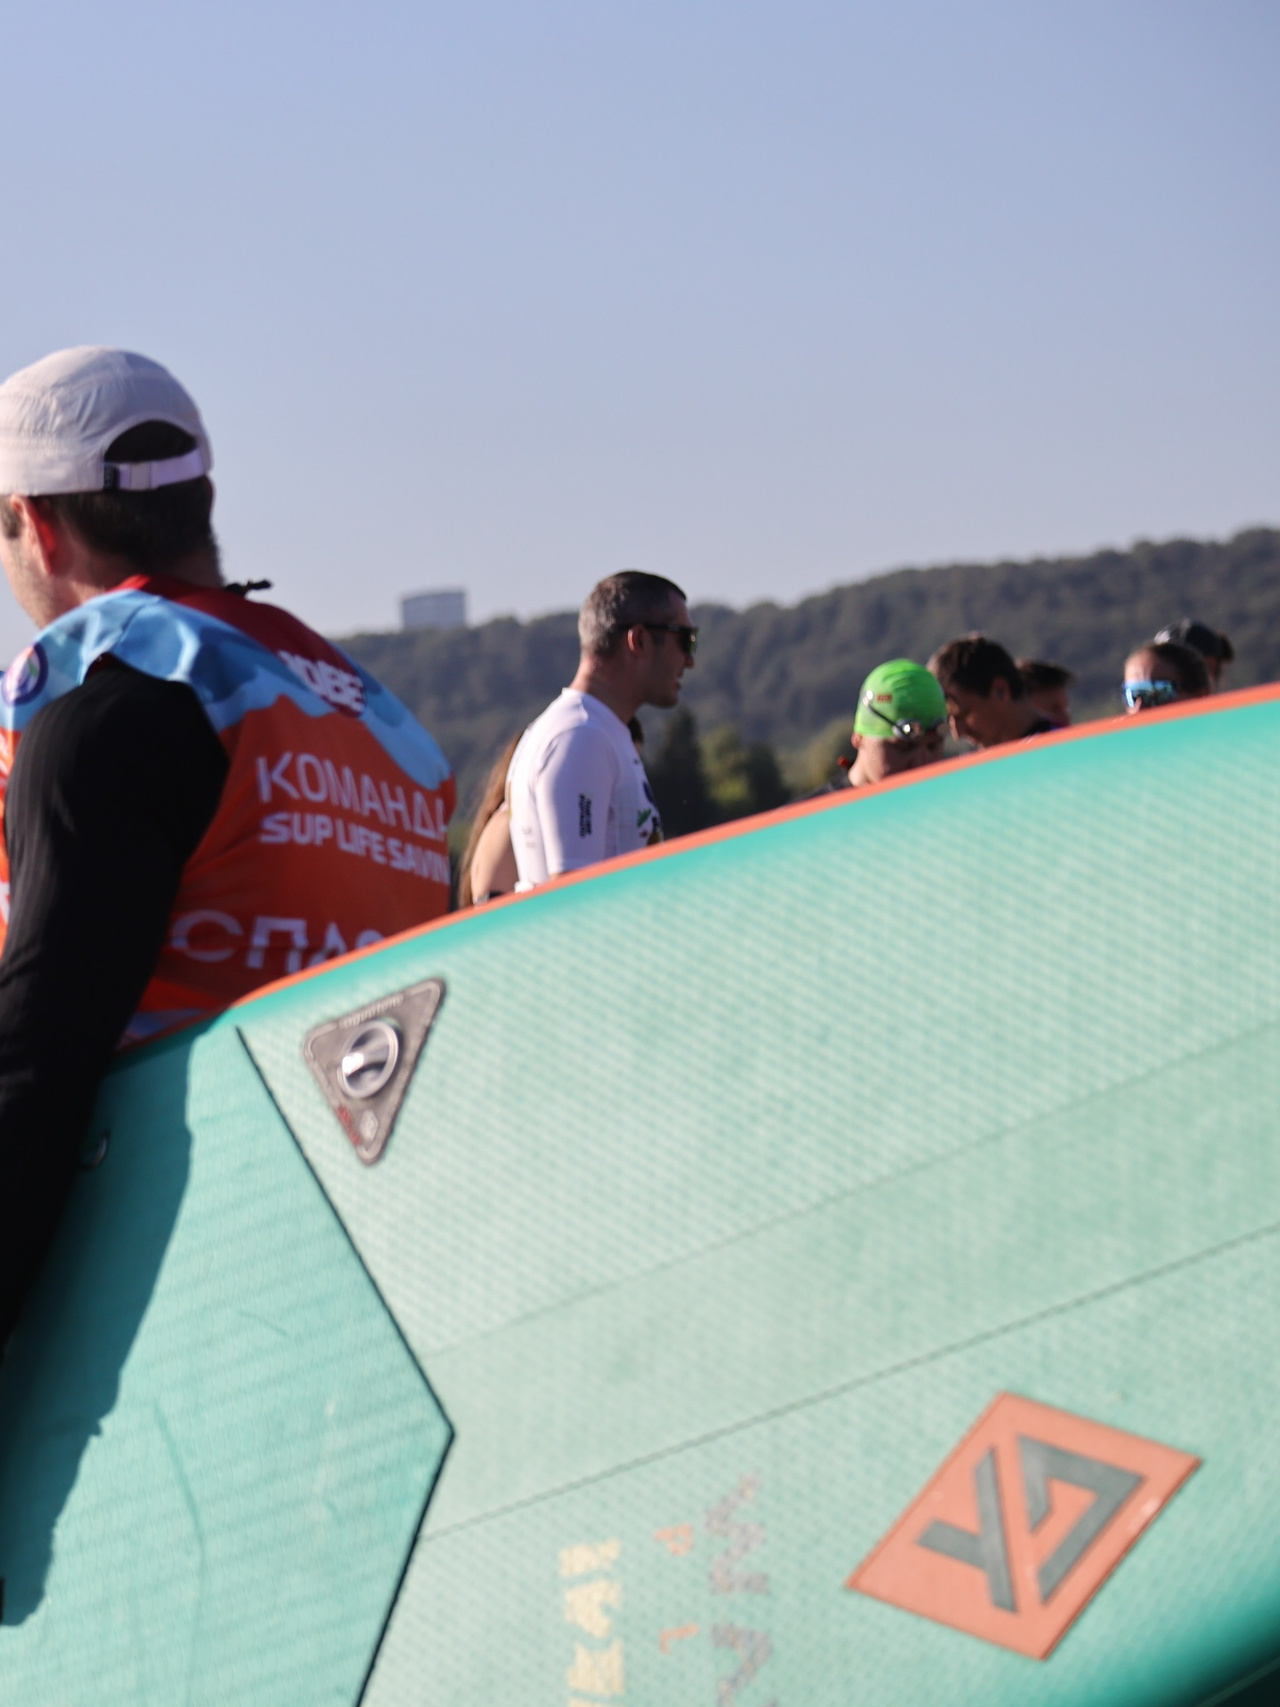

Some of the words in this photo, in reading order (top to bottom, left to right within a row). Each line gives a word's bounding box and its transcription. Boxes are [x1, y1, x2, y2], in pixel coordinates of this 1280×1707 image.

[259, 811, 334, 844] SUP
[335, 818, 387, 866] LIFE
[386, 837, 451, 886] SAVIN
